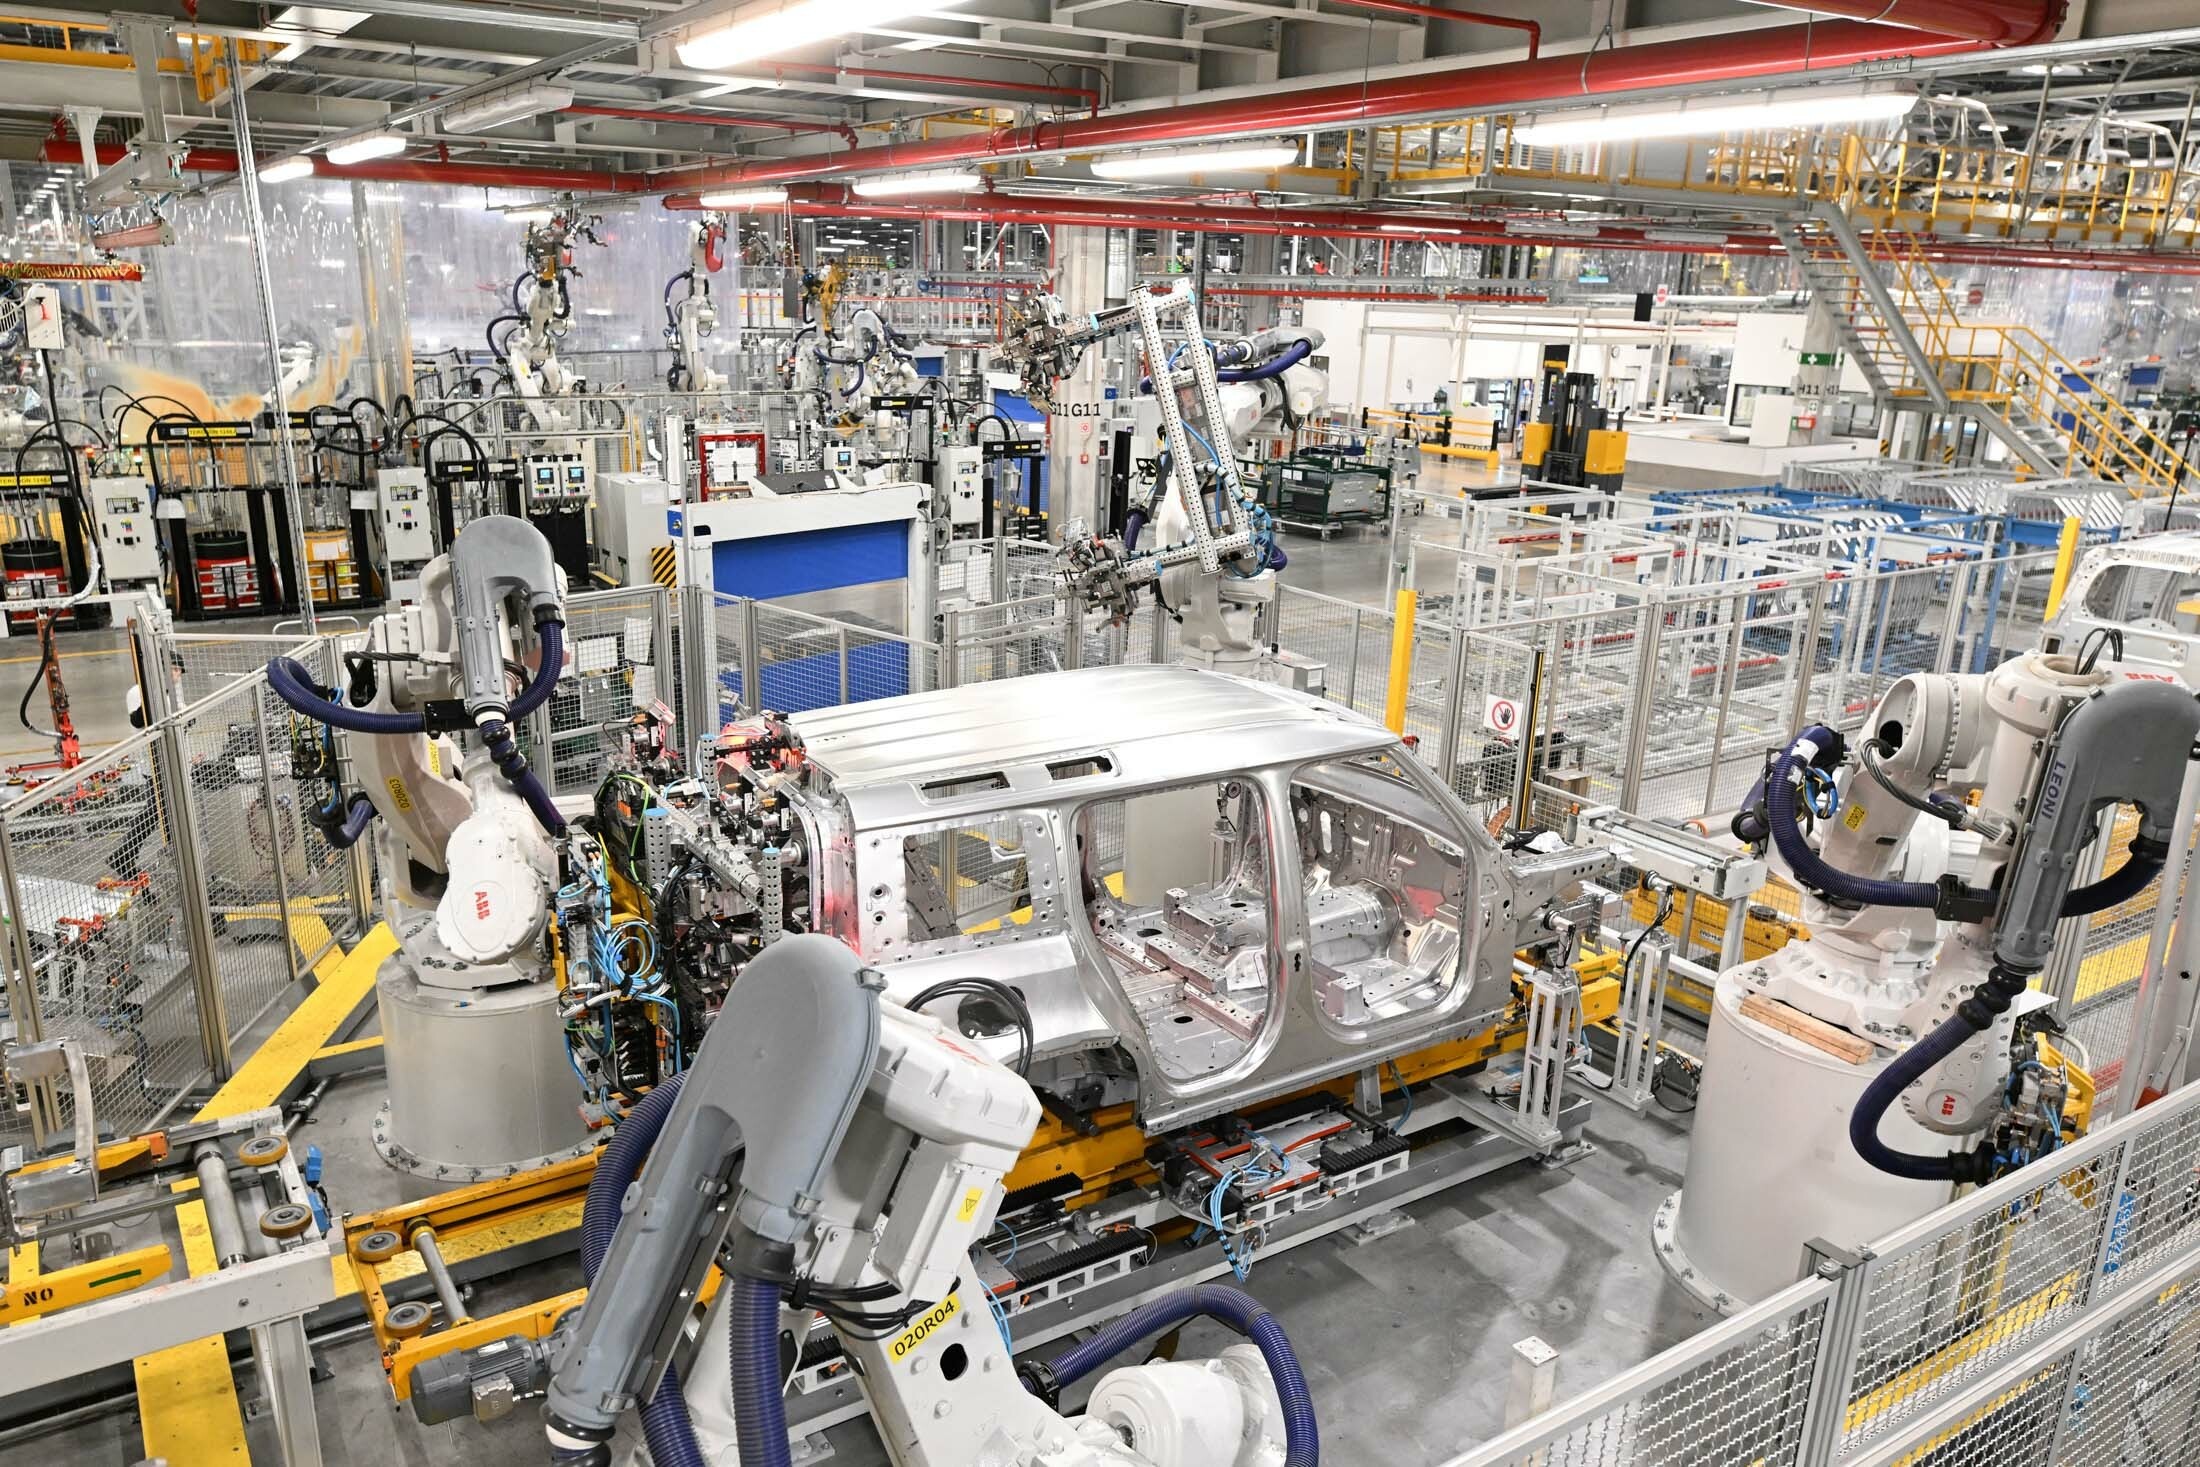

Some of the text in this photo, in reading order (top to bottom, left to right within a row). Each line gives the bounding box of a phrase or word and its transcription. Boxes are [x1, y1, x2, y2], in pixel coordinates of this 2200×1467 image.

[1071, 402, 1101, 417] G11
[389, 777, 410, 809] 020R03
[2041, 760, 2066, 820] LEONI
[474, 891, 490, 920] ABB
[1941, 1095, 1956, 1116] ABB
[23, 1288, 54, 1307] NO
[894, 1300, 955, 1356] 020R04
